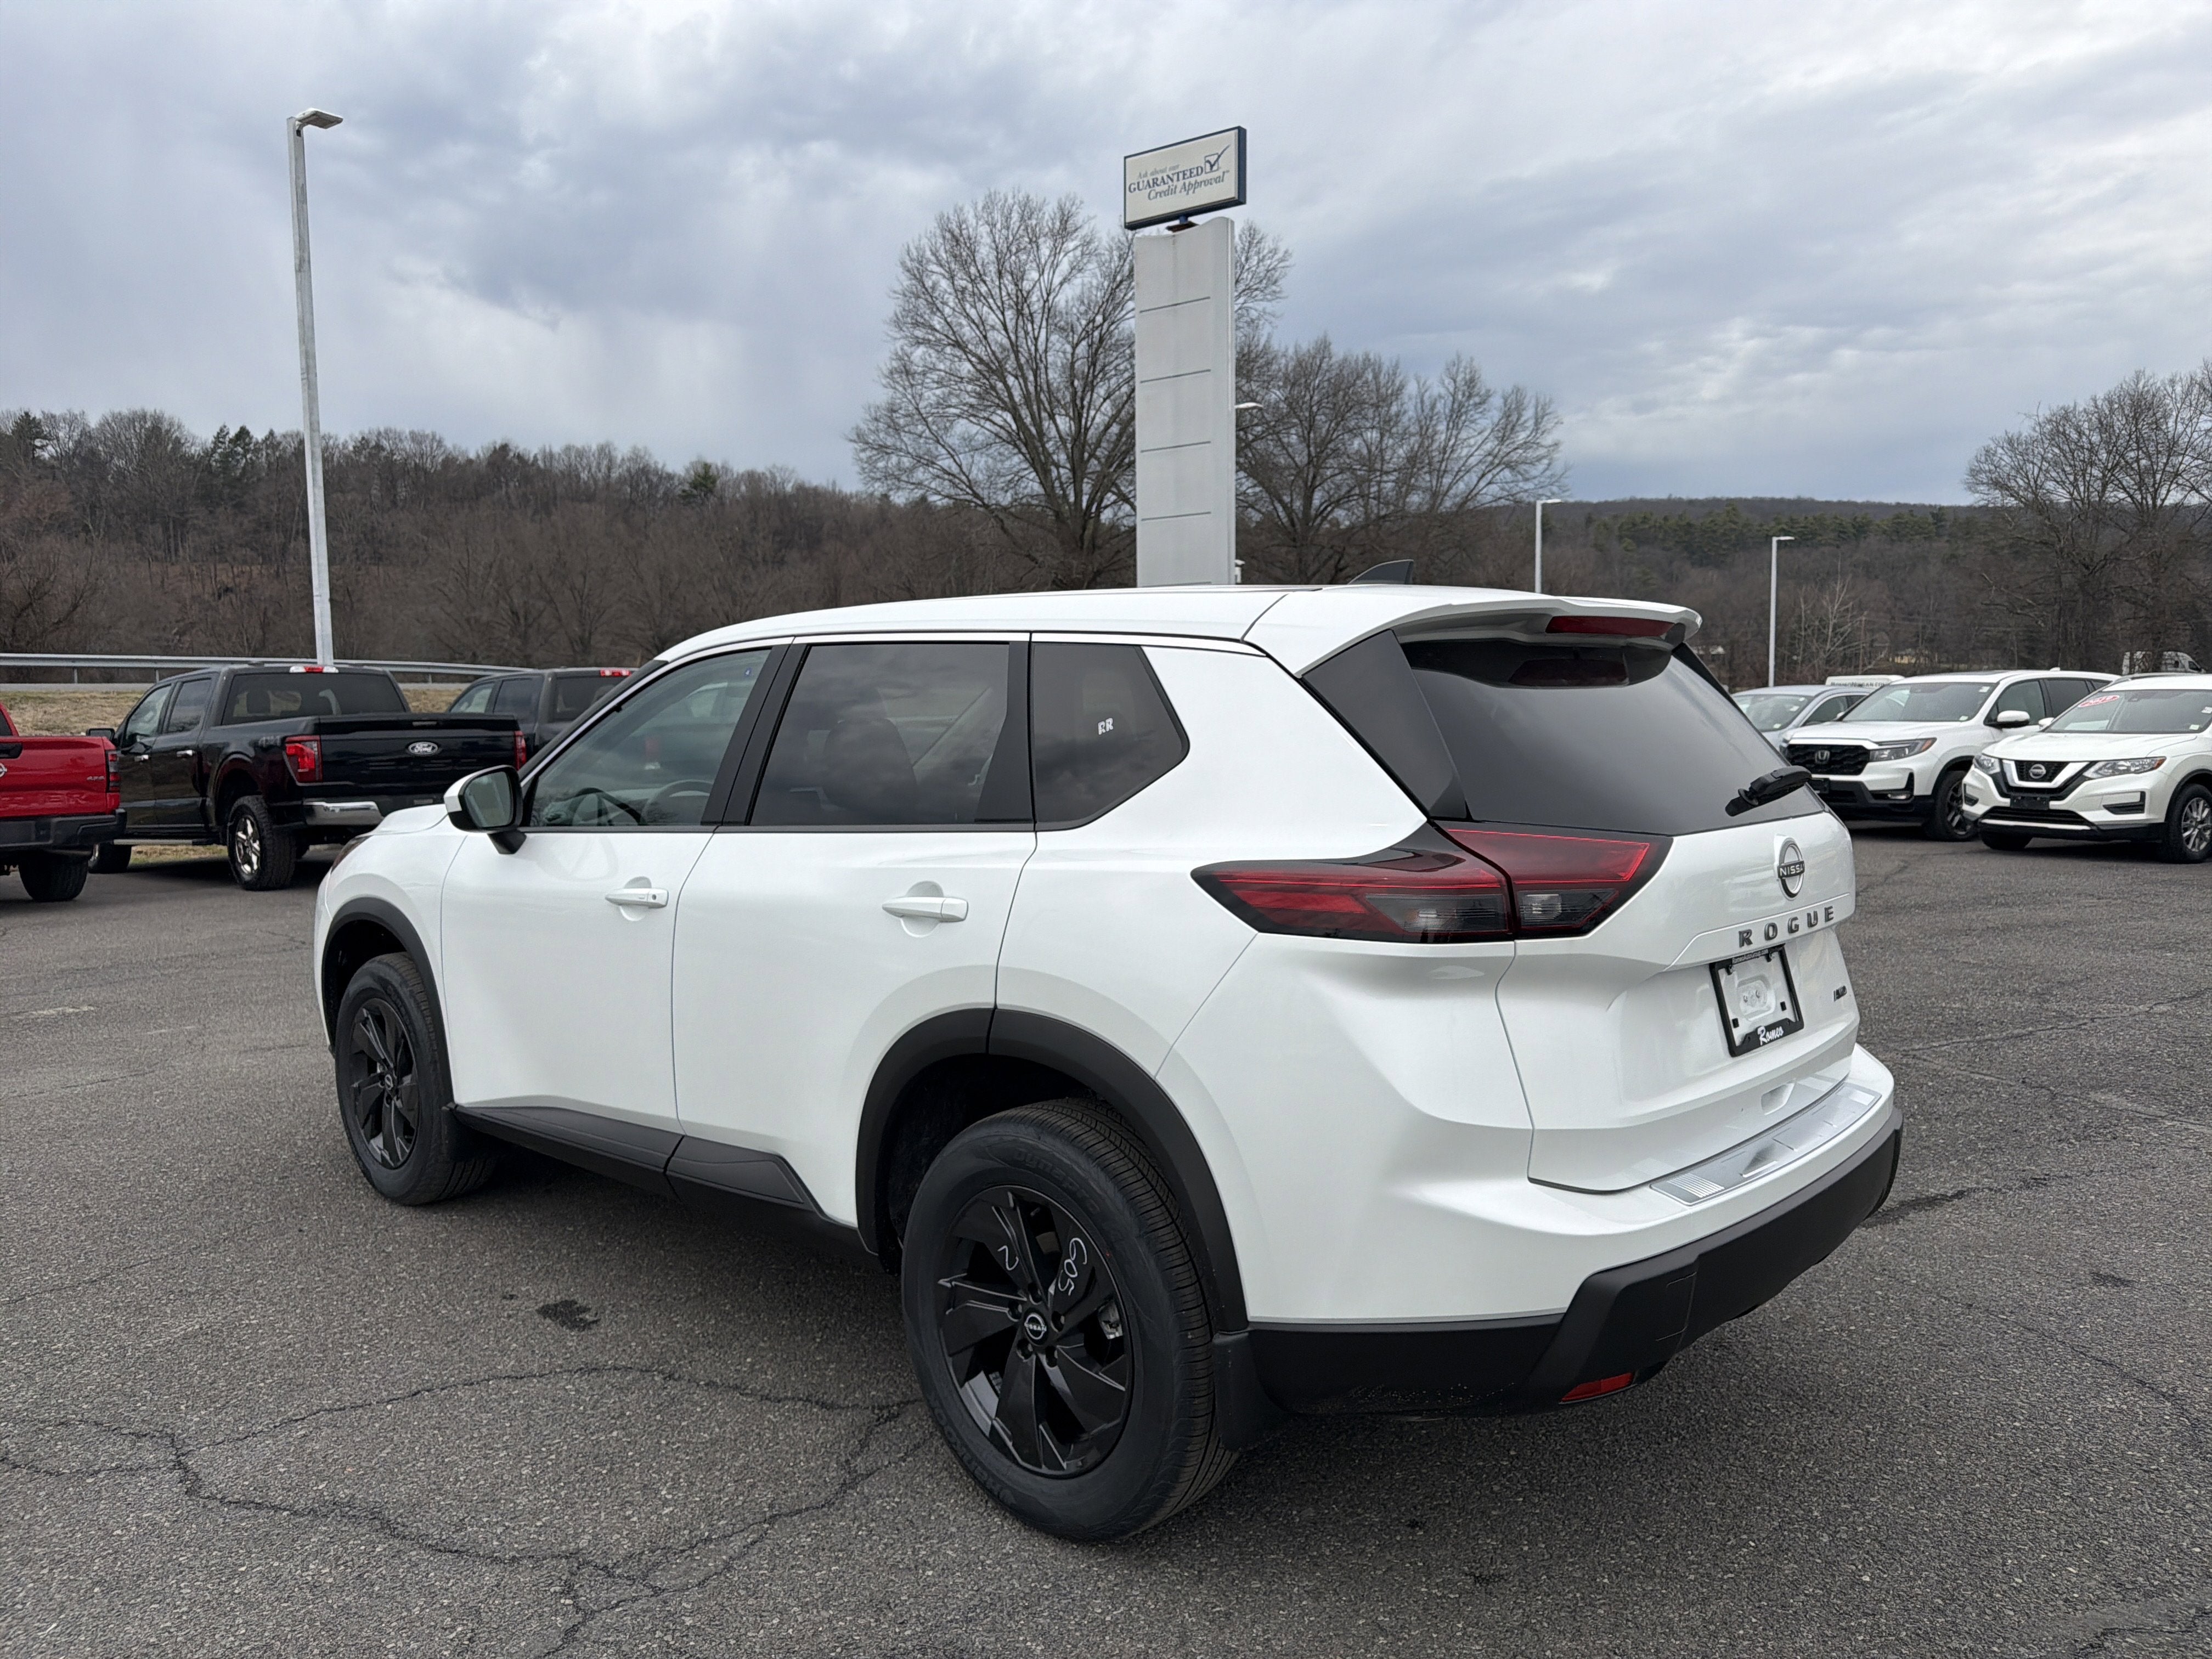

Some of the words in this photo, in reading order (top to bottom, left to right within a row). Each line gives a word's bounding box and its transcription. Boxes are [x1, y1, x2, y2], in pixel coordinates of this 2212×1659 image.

[1128, 166, 1204, 193] GUARANTEED
[1149, 166, 1167, 177] about
[1148, 184, 1177, 201] Credit
[1098, 718, 1114, 735] RR
[1739, 905, 1835, 948] ROGUE
[1757, 1025, 1784, 1046] Romeo
